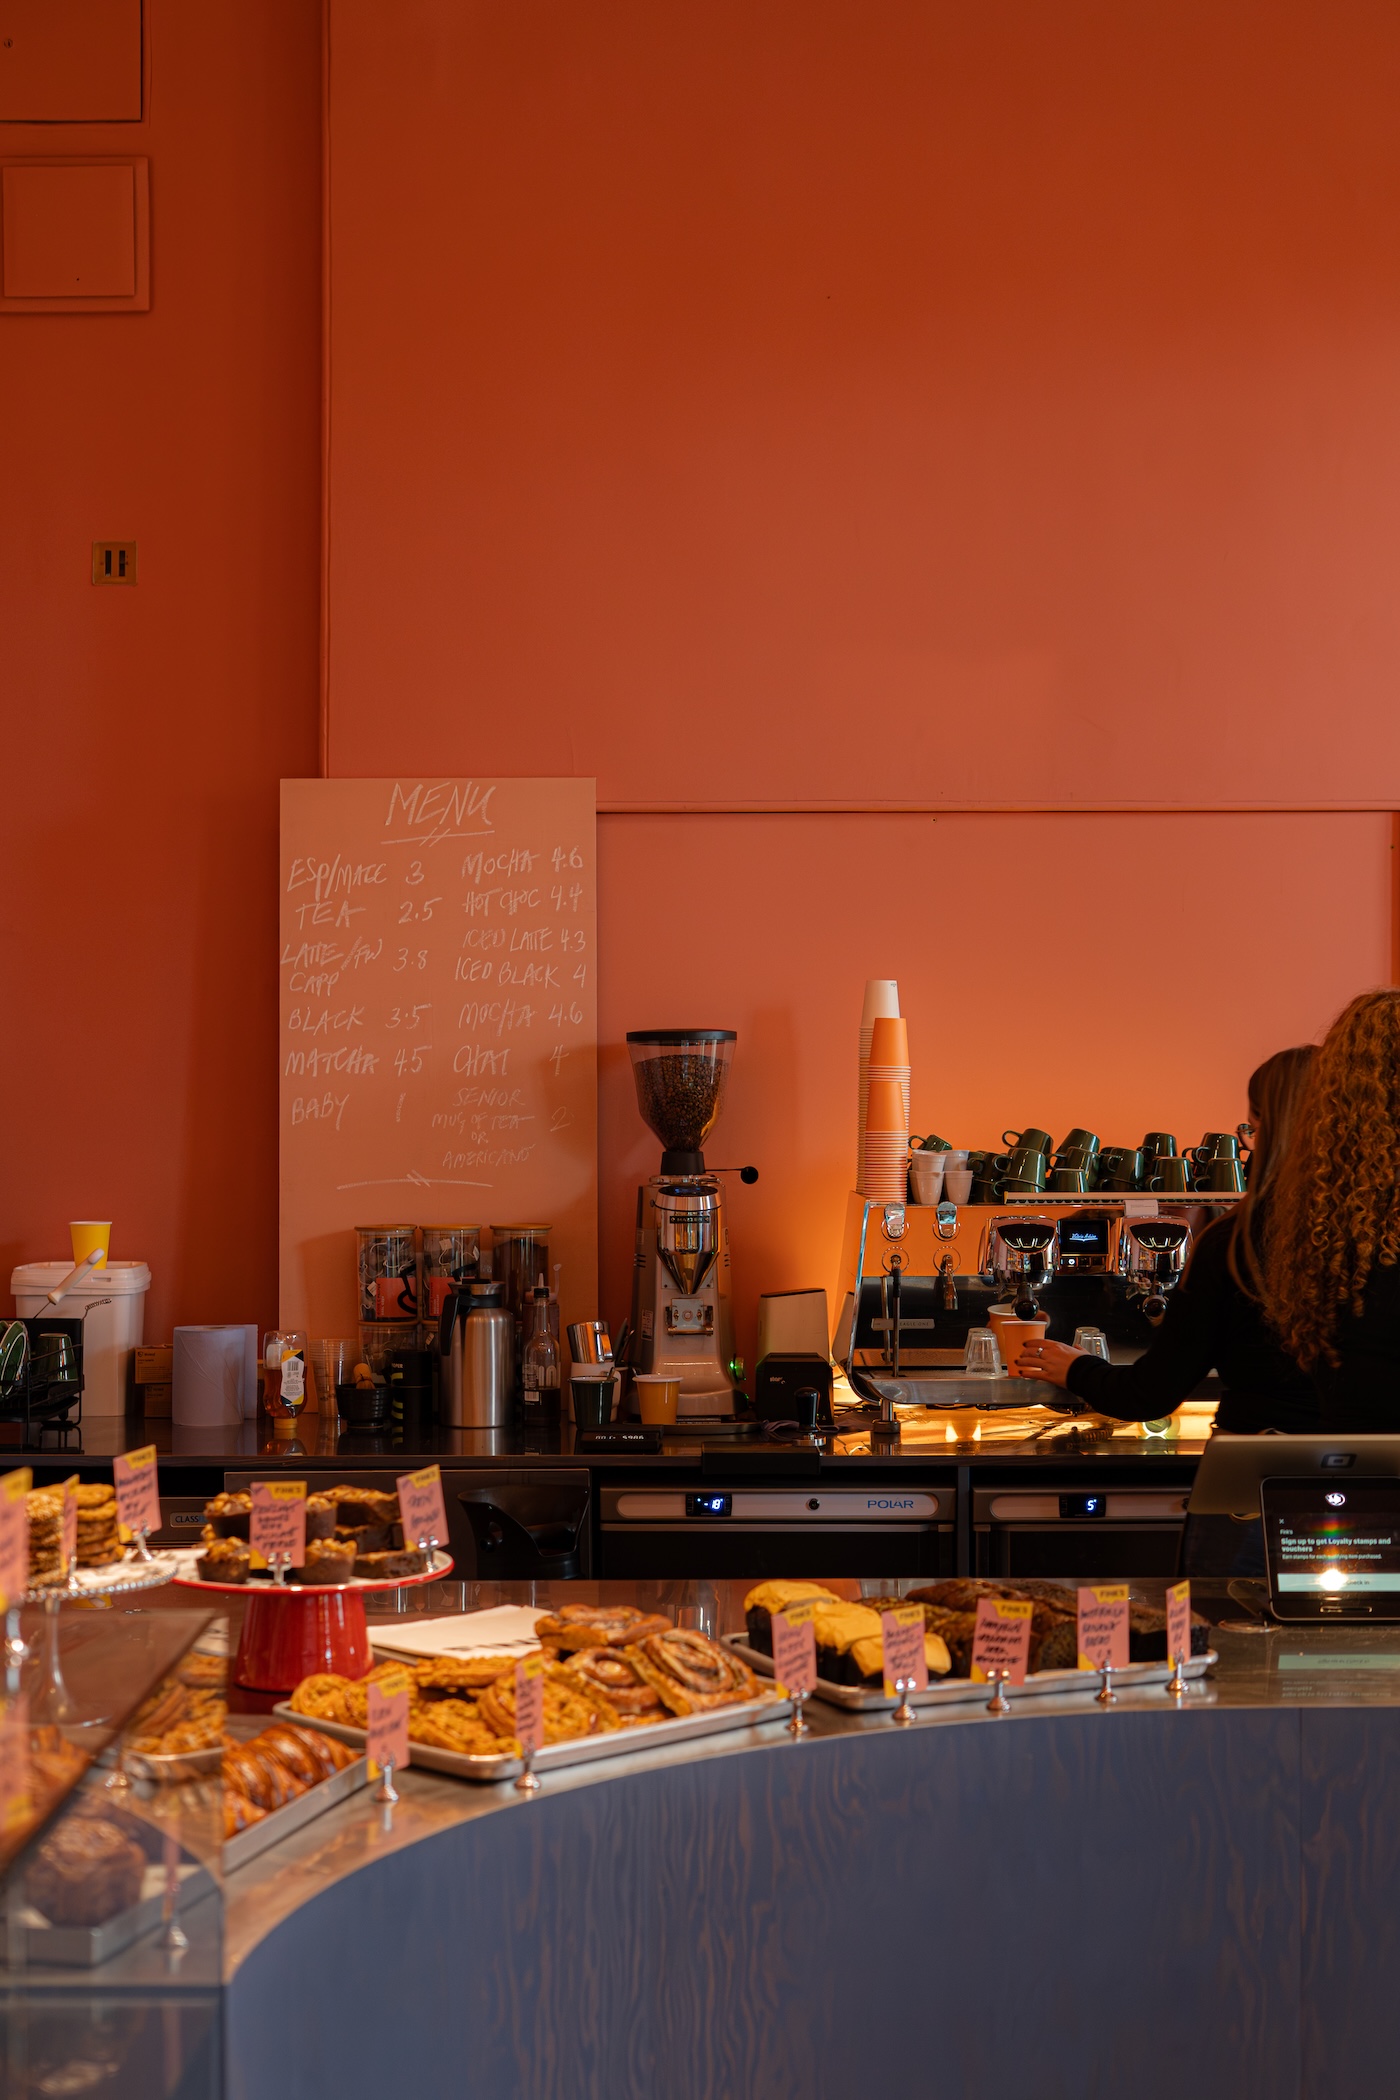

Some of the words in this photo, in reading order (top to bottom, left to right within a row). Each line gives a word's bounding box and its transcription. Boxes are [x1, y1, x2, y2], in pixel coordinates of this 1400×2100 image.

[384, 781, 496, 826] MENU
[405, 860, 425, 885] 3
[461, 848, 540, 884] MOCHA
[551, 845, 583, 872] 4.6
[295, 900, 367, 931] TEA
[398, 897, 443, 924] 2.5
[462, 887, 503, 917] HOT
[499, 888, 541, 916] CHOC
[551, 882, 582, 912] 4.4
[462, 928, 506, 951] ICED
[509, 927, 553, 952] LATTE
[561, 927, 586, 952] 4.3
[393, 948, 428, 972] 3.8
[455, 956, 492, 981] ICED
[498, 961, 560, 989] BLACK
[573, 964, 586, 988] 4
[288, 1003, 365, 1036] BLACK
[458, 998, 538, 1037] MOCHA
[548, 1001, 583, 1028] 4.6
[285, 1045, 380, 1077] MATCHA
[394, 1045, 432, 1078] 4.5
[549, 1044, 569, 1077] 4
[292, 1092, 350, 1131] BABY
[452, 1086, 526, 1107] SENIOR
[431, 1112, 466, 1136] MUG
[471, 1112, 488, 1130] OF
[490, 1114, 536, 1131] TEA
[549, 1106, 571, 1132] 2
[867, 1499, 914, 1509] POLAR
[1281, 1538, 1297, 1546] Sign
[1316, 1538, 1328, 1547] get
[1328, 1538, 1353, 1547] Loyalty
[1353, 1538, 1378, 1546] stamps
[1378, 1537, 1392, 1545] and
[1281, 1545, 1313, 1553] vouchers
